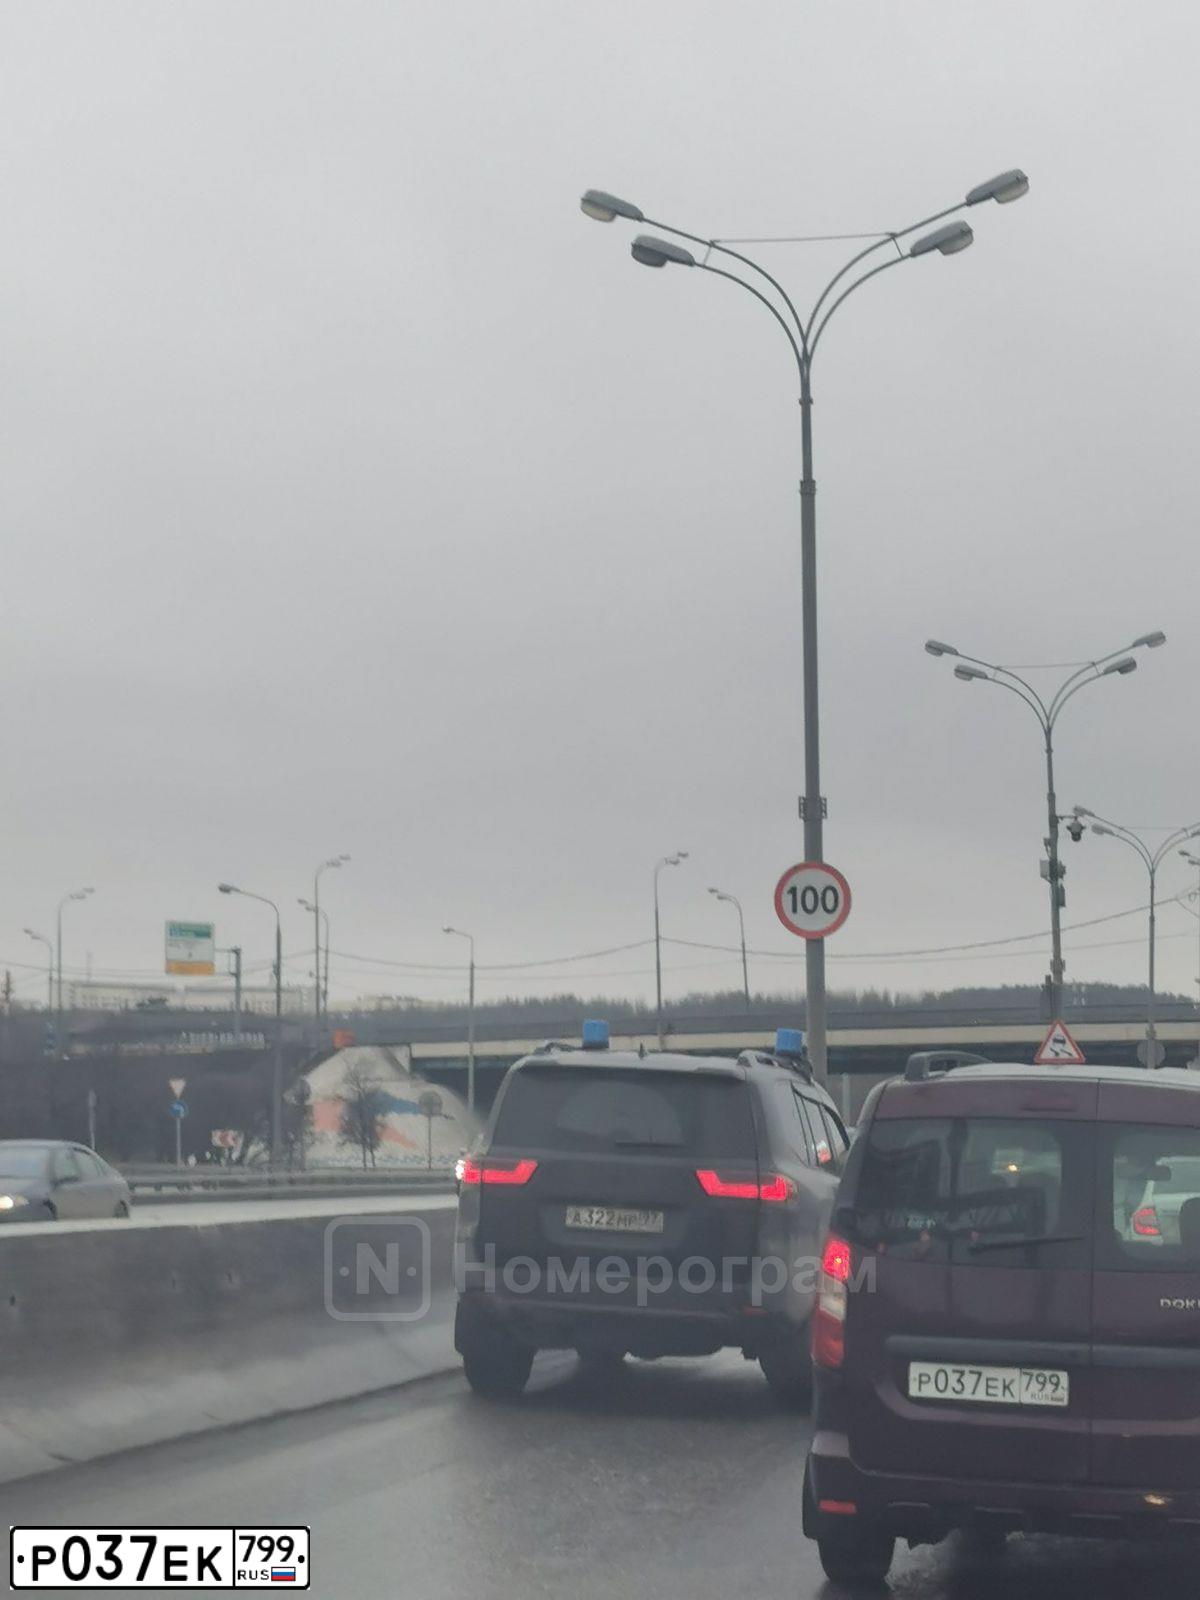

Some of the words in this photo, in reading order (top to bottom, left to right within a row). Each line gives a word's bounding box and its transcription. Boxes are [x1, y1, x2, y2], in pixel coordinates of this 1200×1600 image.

[787, 885, 838, 914] 100
[918, 1369, 1015, 1397] Р037ЕК
[1023, 1371, 1061, 1393] 799
